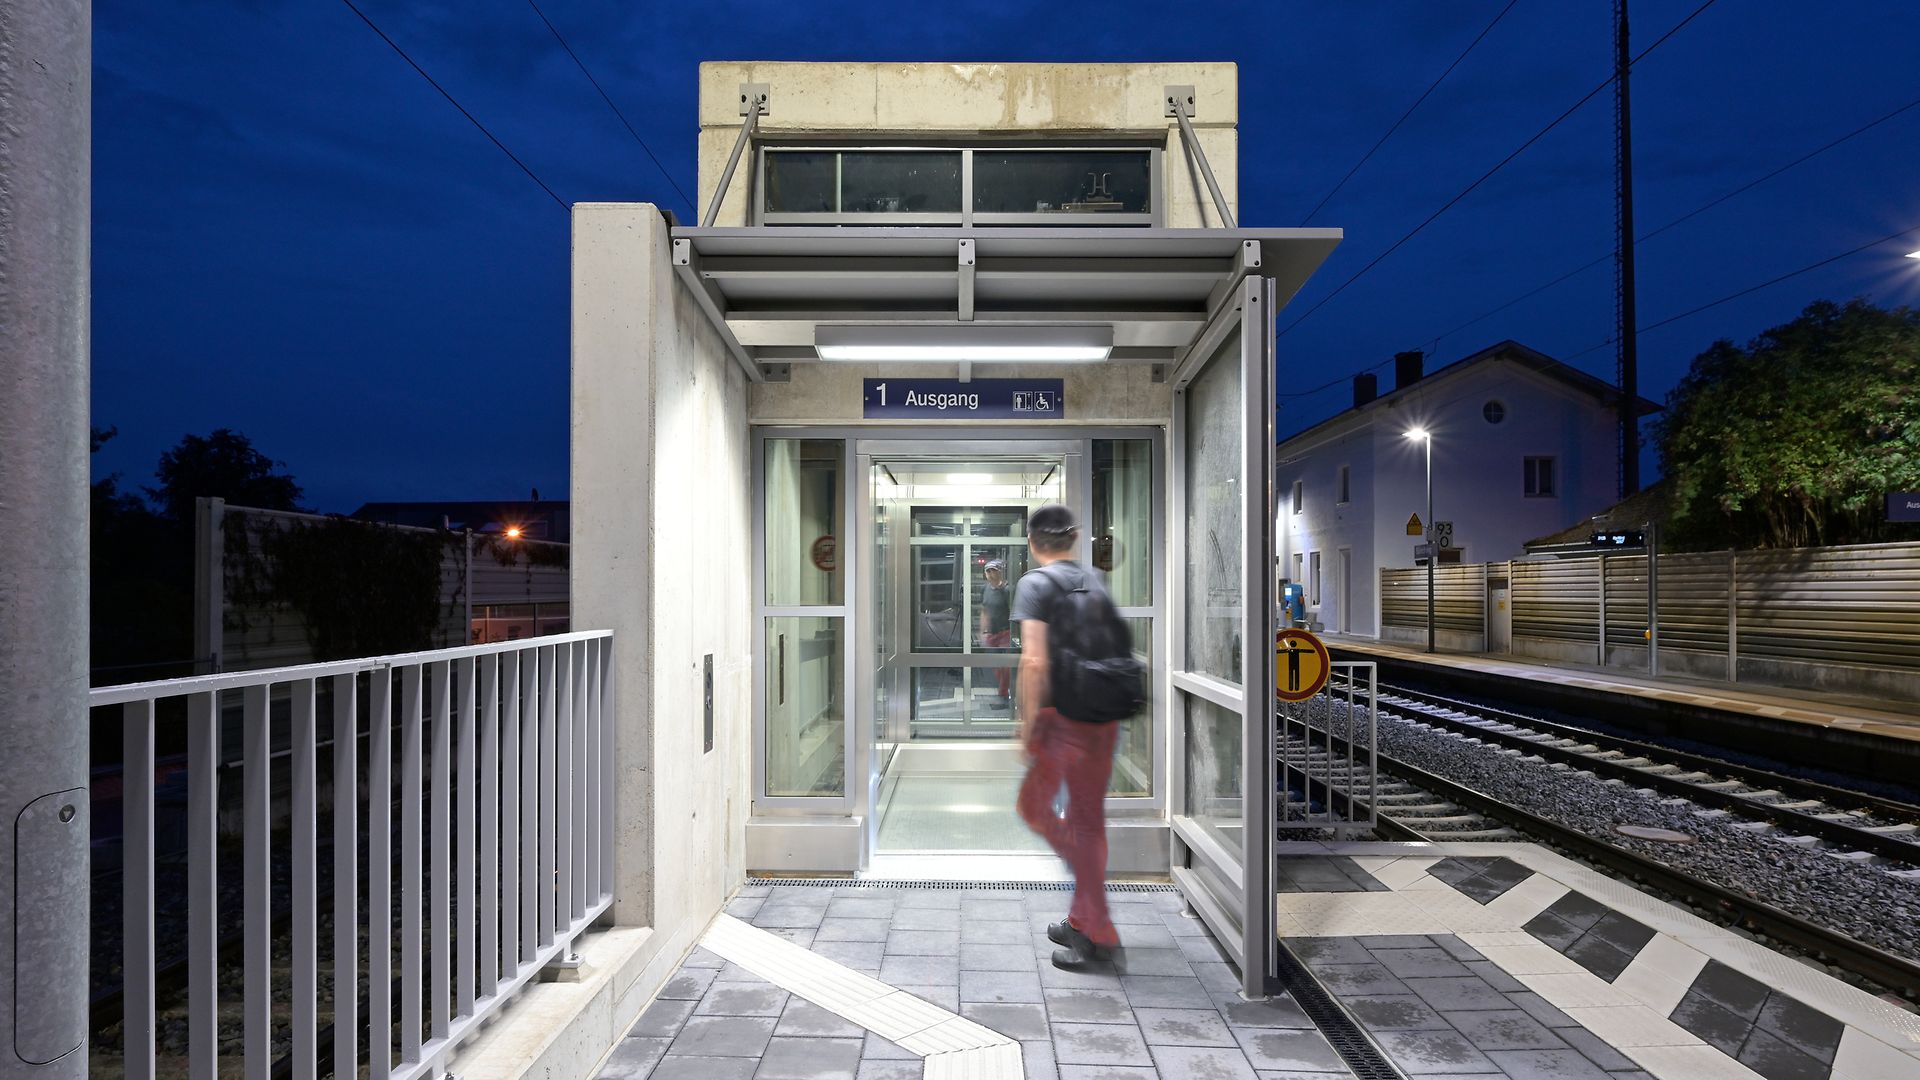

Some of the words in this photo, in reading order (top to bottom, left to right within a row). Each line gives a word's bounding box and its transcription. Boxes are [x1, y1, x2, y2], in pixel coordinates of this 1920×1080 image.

[876, 383, 887, 406] 1
[905, 390, 979, 409] Ausgang
[1437, 523, 1453, 536] 93
